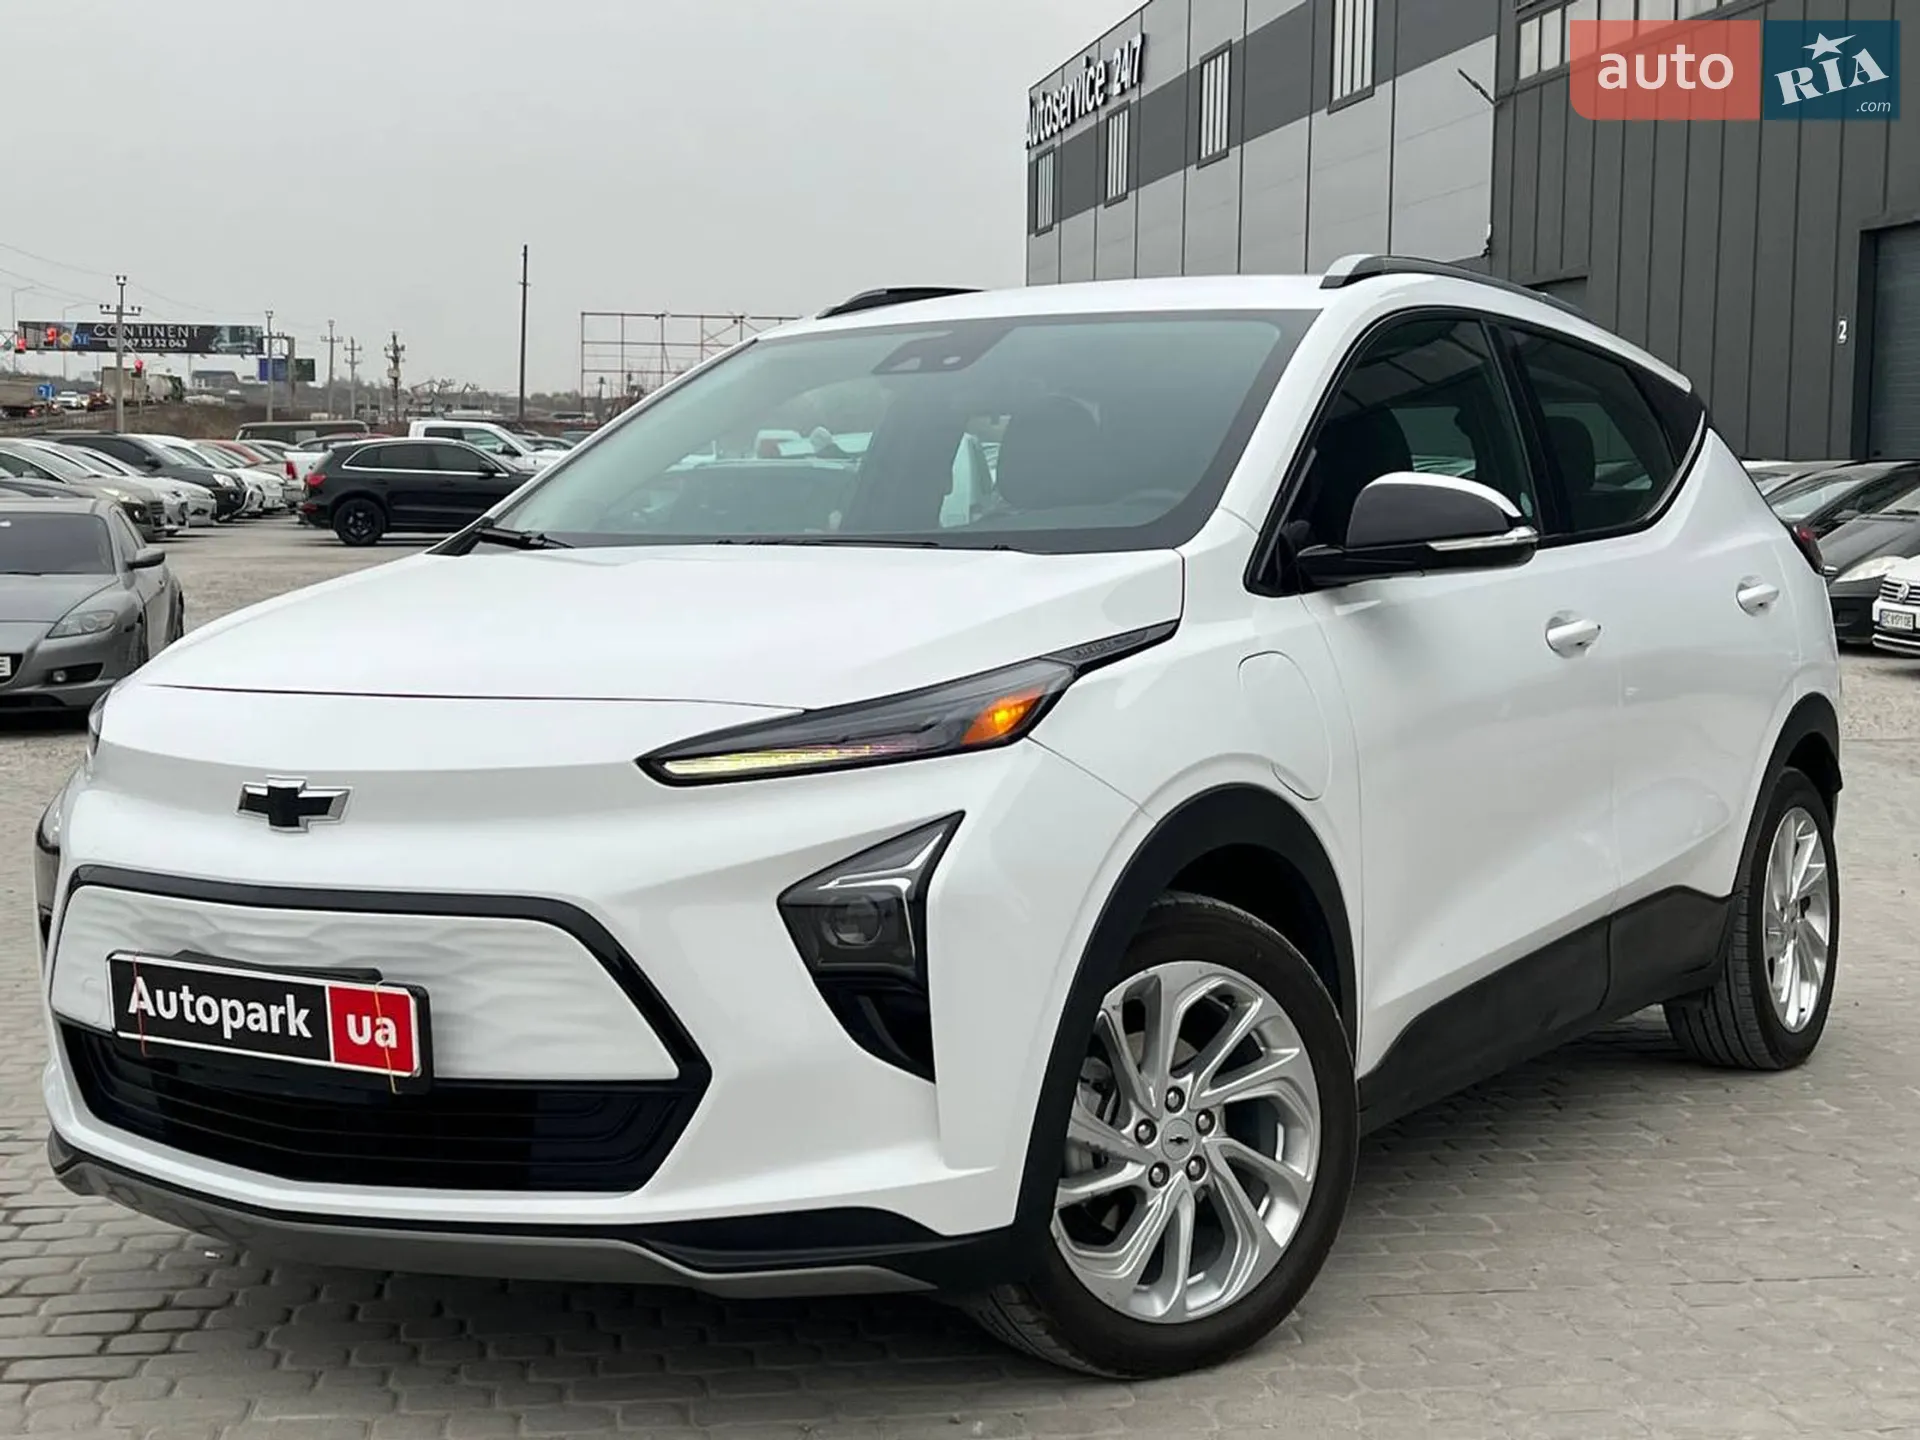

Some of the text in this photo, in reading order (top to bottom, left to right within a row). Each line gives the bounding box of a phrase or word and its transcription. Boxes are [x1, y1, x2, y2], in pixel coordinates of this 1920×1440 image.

[1025, 55, 1106, 150] Autoservice
[93, 323, 200, 338] CONTINENT
[1837, 319, 1848, 344] 2
[128, 976, 398, 1049] Autopark ua
